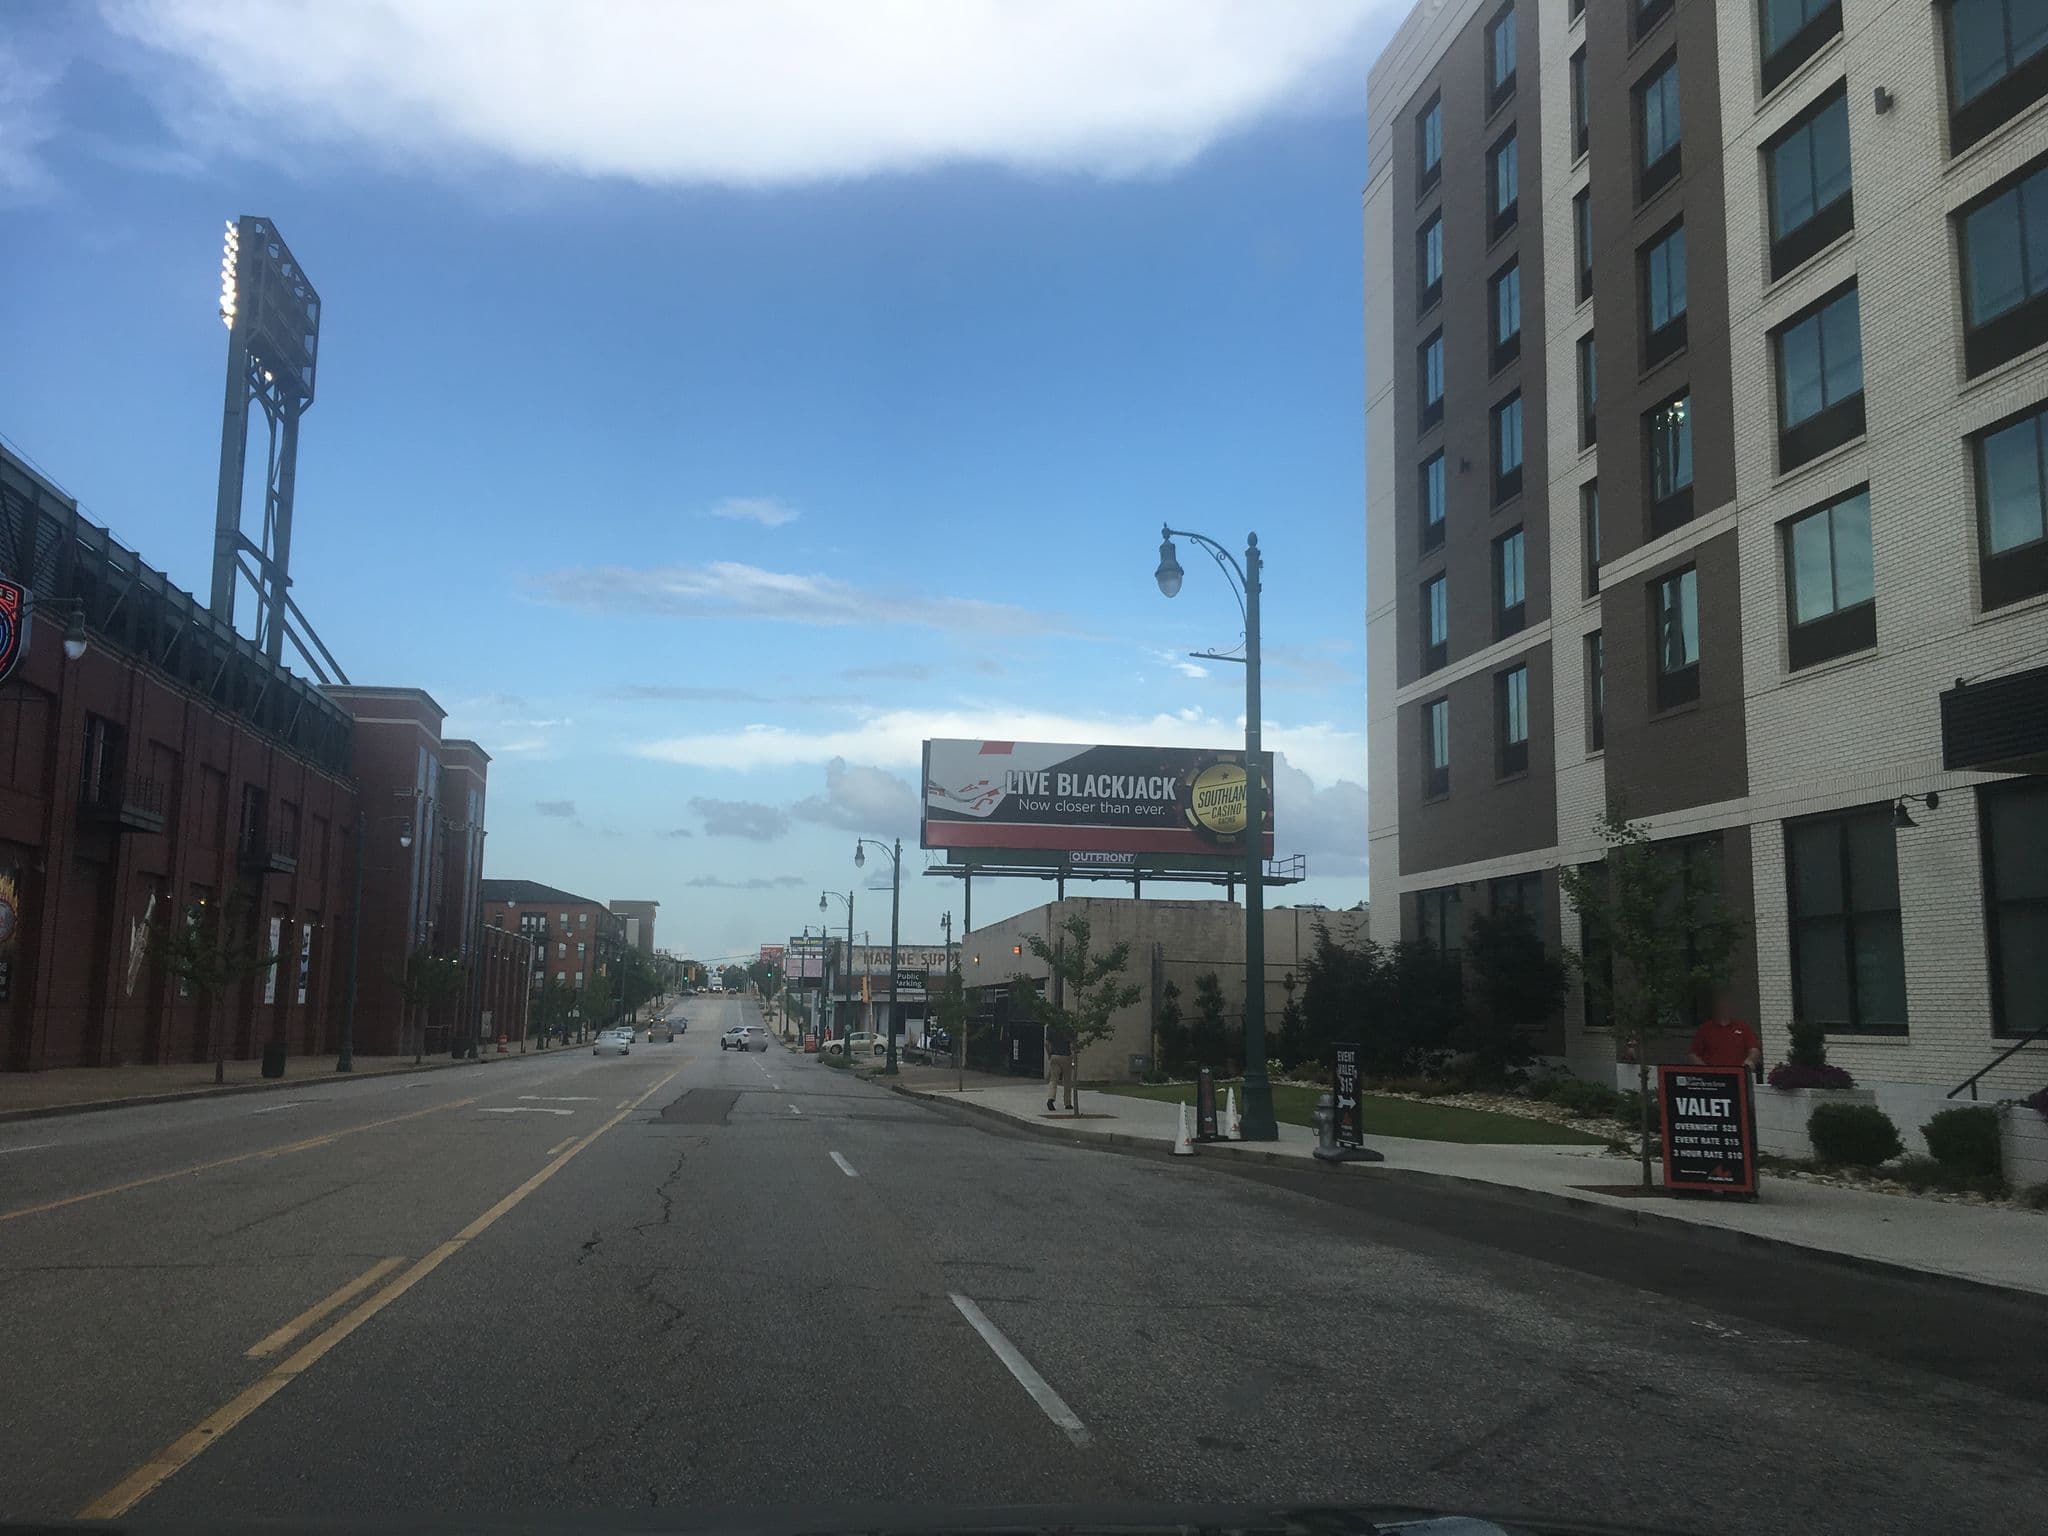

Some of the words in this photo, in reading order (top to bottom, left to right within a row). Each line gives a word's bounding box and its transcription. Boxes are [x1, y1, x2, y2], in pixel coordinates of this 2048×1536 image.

[1006, 770, 1050, 796] LIVE
[1057, 773, 1177, 801] BLACKJACK
[1198, 785, 1248, 809] SOUTHLAN
[1018, 799, 1051, 812] Now
[1054, 799, 1096, 815] closer
[1099, 801, 1131, 815] than
[1134, 803, 1166, 816] ever.
[1211, 803, 1242, 819] CASINO
[1071, 851, 1135, 864] OUTFRONT
[863, 951, 914, 966] MARNE
[897, 972, 919, 980] Public
[1337, 1051, 1355, 1062] EVENT
[1337, 1064, 1355, 1076] VALET
[1675, 1097, 1732, 1117] VALET
[1674, 1122, 1718, 1132] OVERNIGHT
[1674, 1136, 1699, 1144] EVENT
[1700, 1137, 1721, 1146] RATE
[1724, 1138, 1740, 1146] $15
[1673, 1149, 1679, 1157] 3
[1680, 1150, 1702, 1159] HOUR
[1703, 1151, 1723, 1159] RATE
[1727, 1152, 1743, 1160] $10
